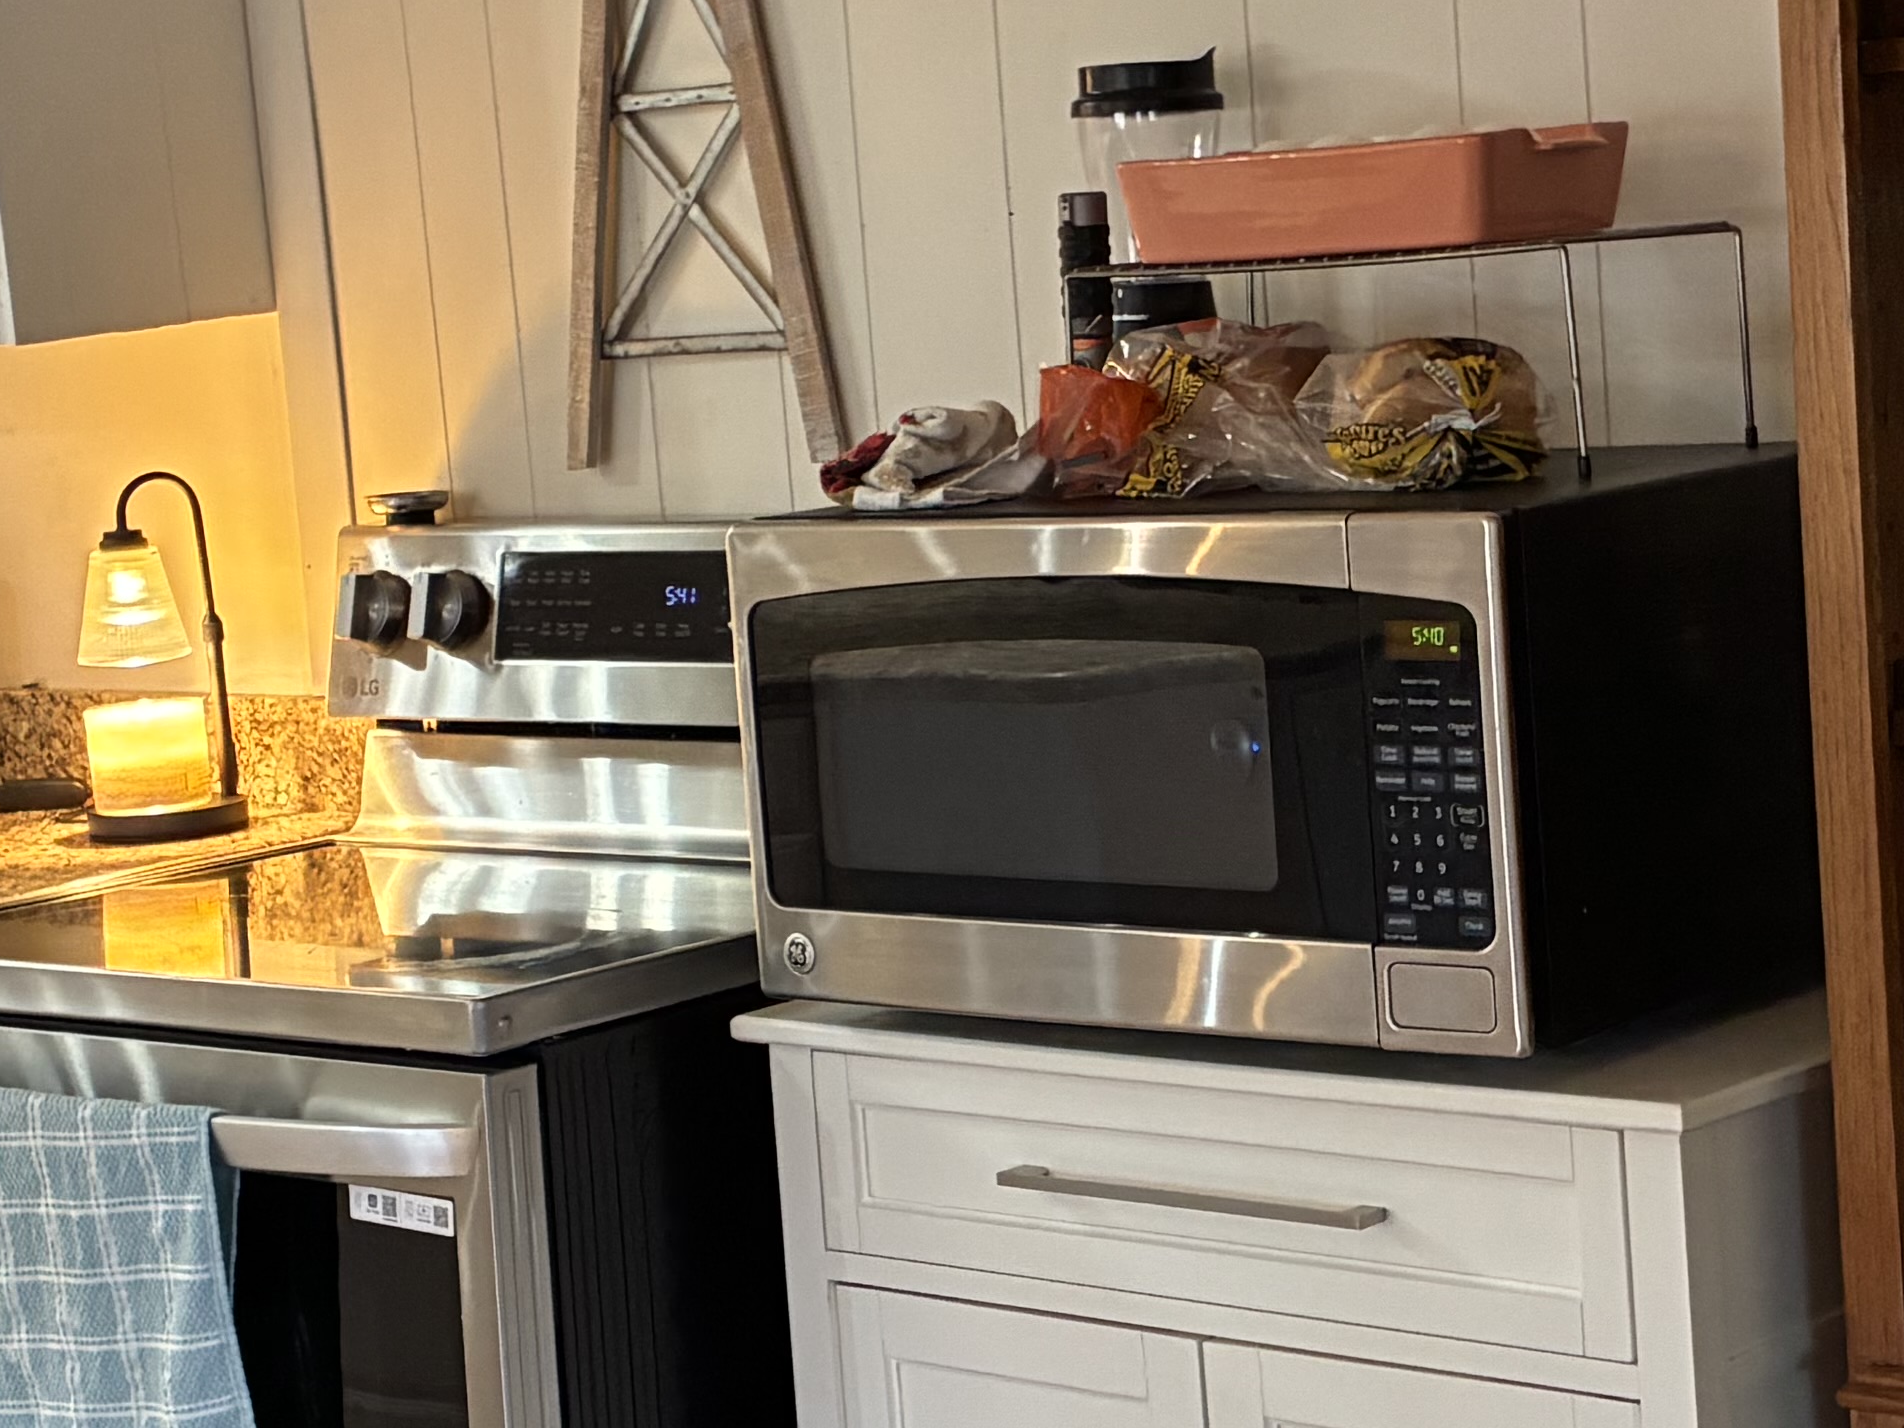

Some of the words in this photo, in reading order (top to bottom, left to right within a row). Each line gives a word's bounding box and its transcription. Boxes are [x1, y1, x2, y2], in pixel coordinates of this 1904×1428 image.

[665, 585, 696, 606] 5:41
[1411, 626, 1445, 646] 5:40
[359, 678, 380, 696] LG
[1412, 805, 1419, 819] 2
[1413, 833, 1422, 846] 5
[1436, 834, 1445, 847] 6
[1437, 862, 1447, 875] 9
